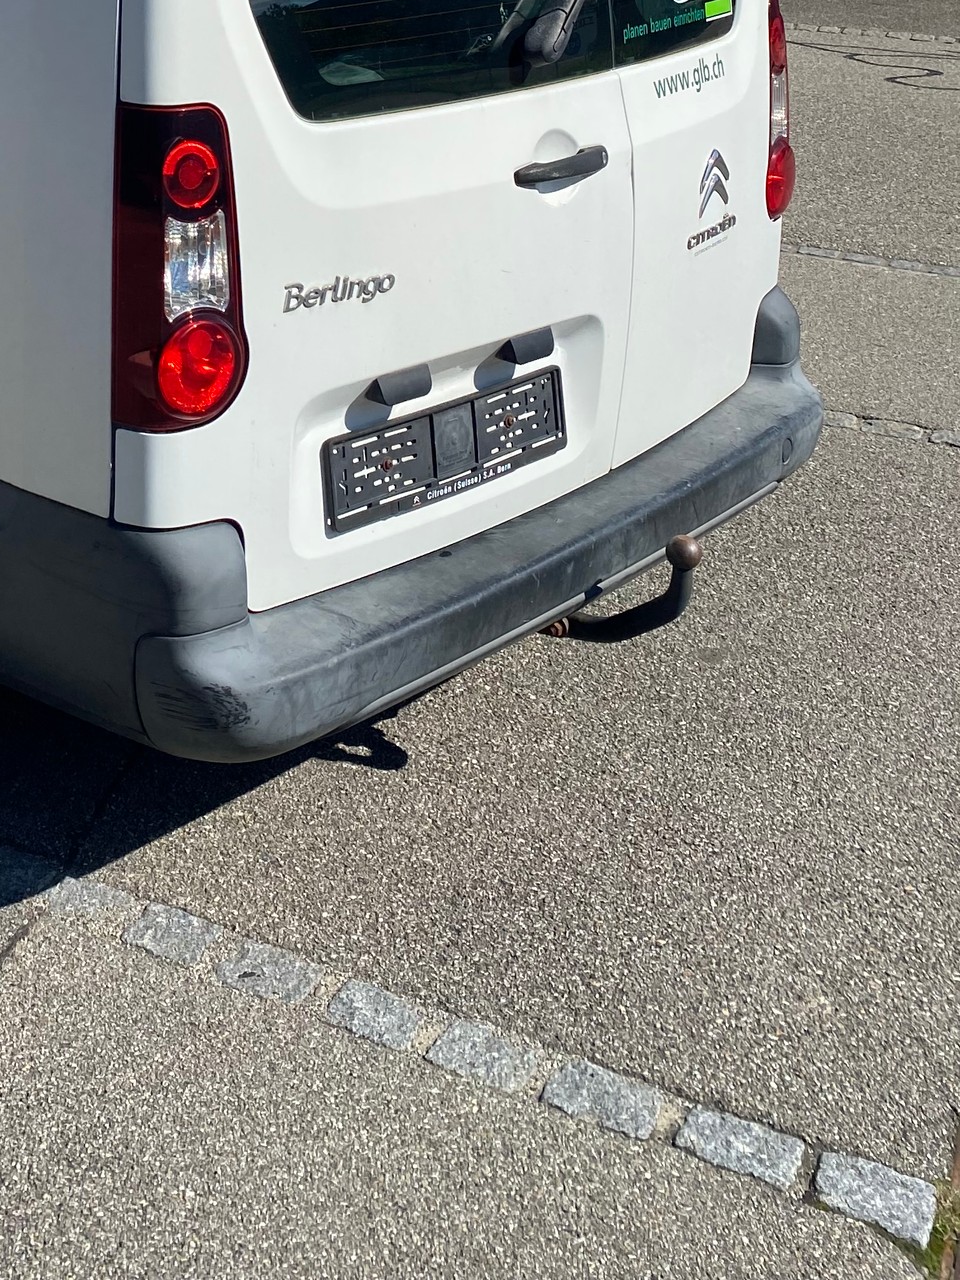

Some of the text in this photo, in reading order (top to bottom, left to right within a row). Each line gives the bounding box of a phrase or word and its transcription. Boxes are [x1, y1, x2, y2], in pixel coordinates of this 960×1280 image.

[623, 8, 705, 44] planen bauen einrichten
[653, 53, 725, 99] www.glb.ch
[282, 273, 396, 314] Berlingo
